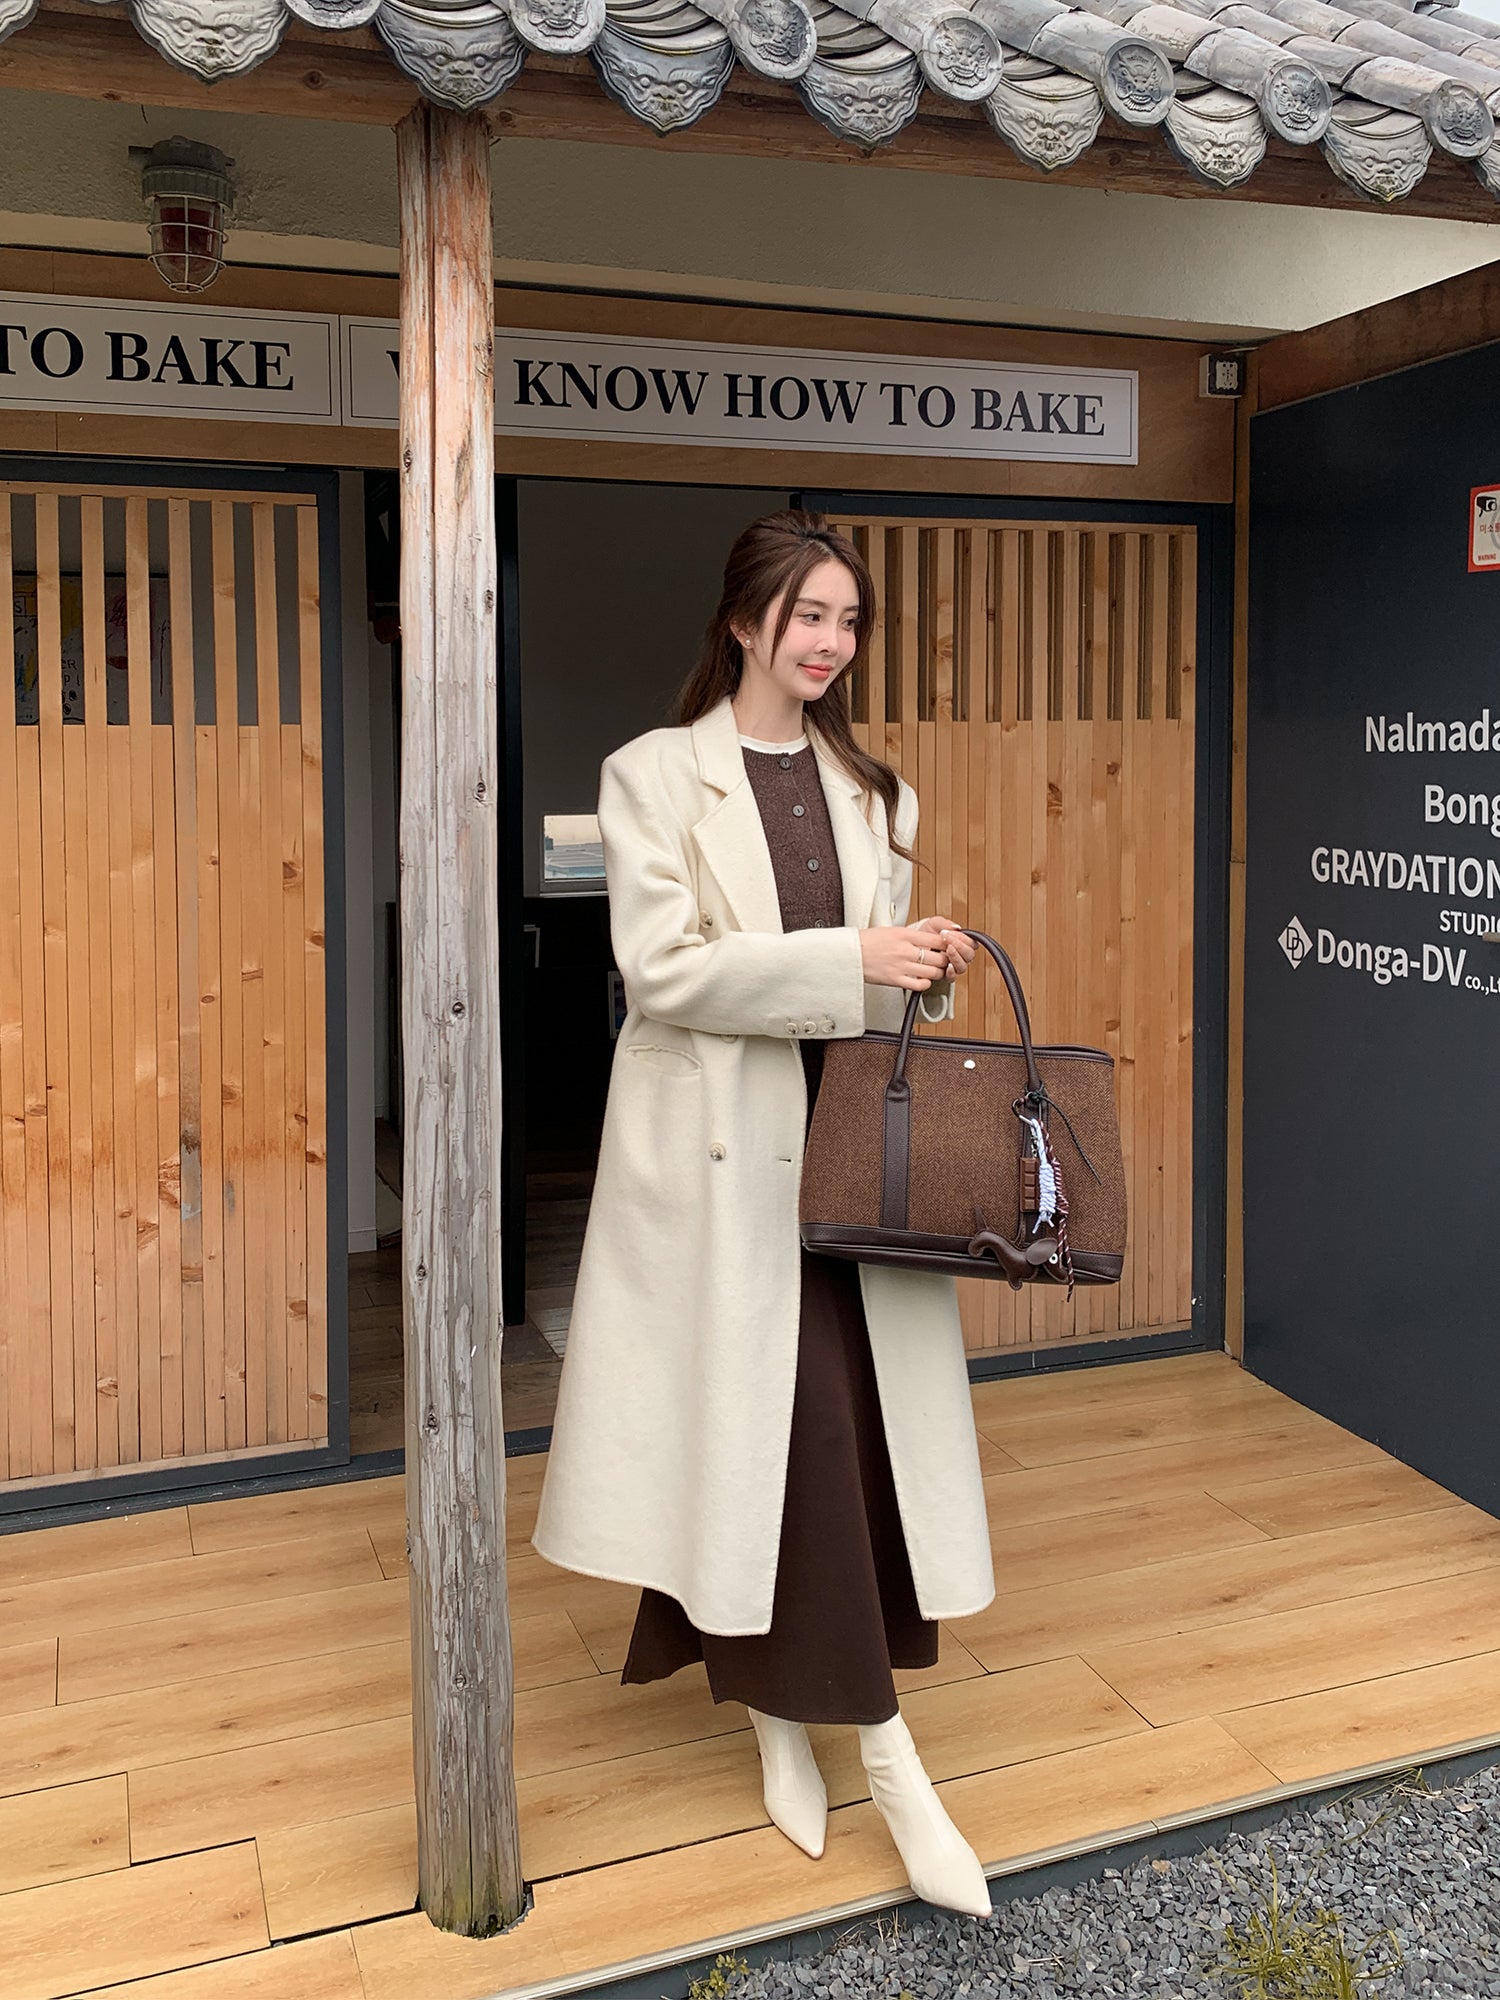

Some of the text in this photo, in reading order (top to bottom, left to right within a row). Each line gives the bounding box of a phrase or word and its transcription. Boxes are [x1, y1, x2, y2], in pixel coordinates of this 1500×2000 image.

[0, 325, 294, 391] TO BAKE
[513, 359, 709, 415] KNOW
[723, 372, 868, 424] HOW
[880, 382, 956, 428] TO
[970, 388, 1105, 436] BAKE
[1311, 847, 1500, 899] GRAYDATION
[1439, 910, 1500, 936] STUDI
